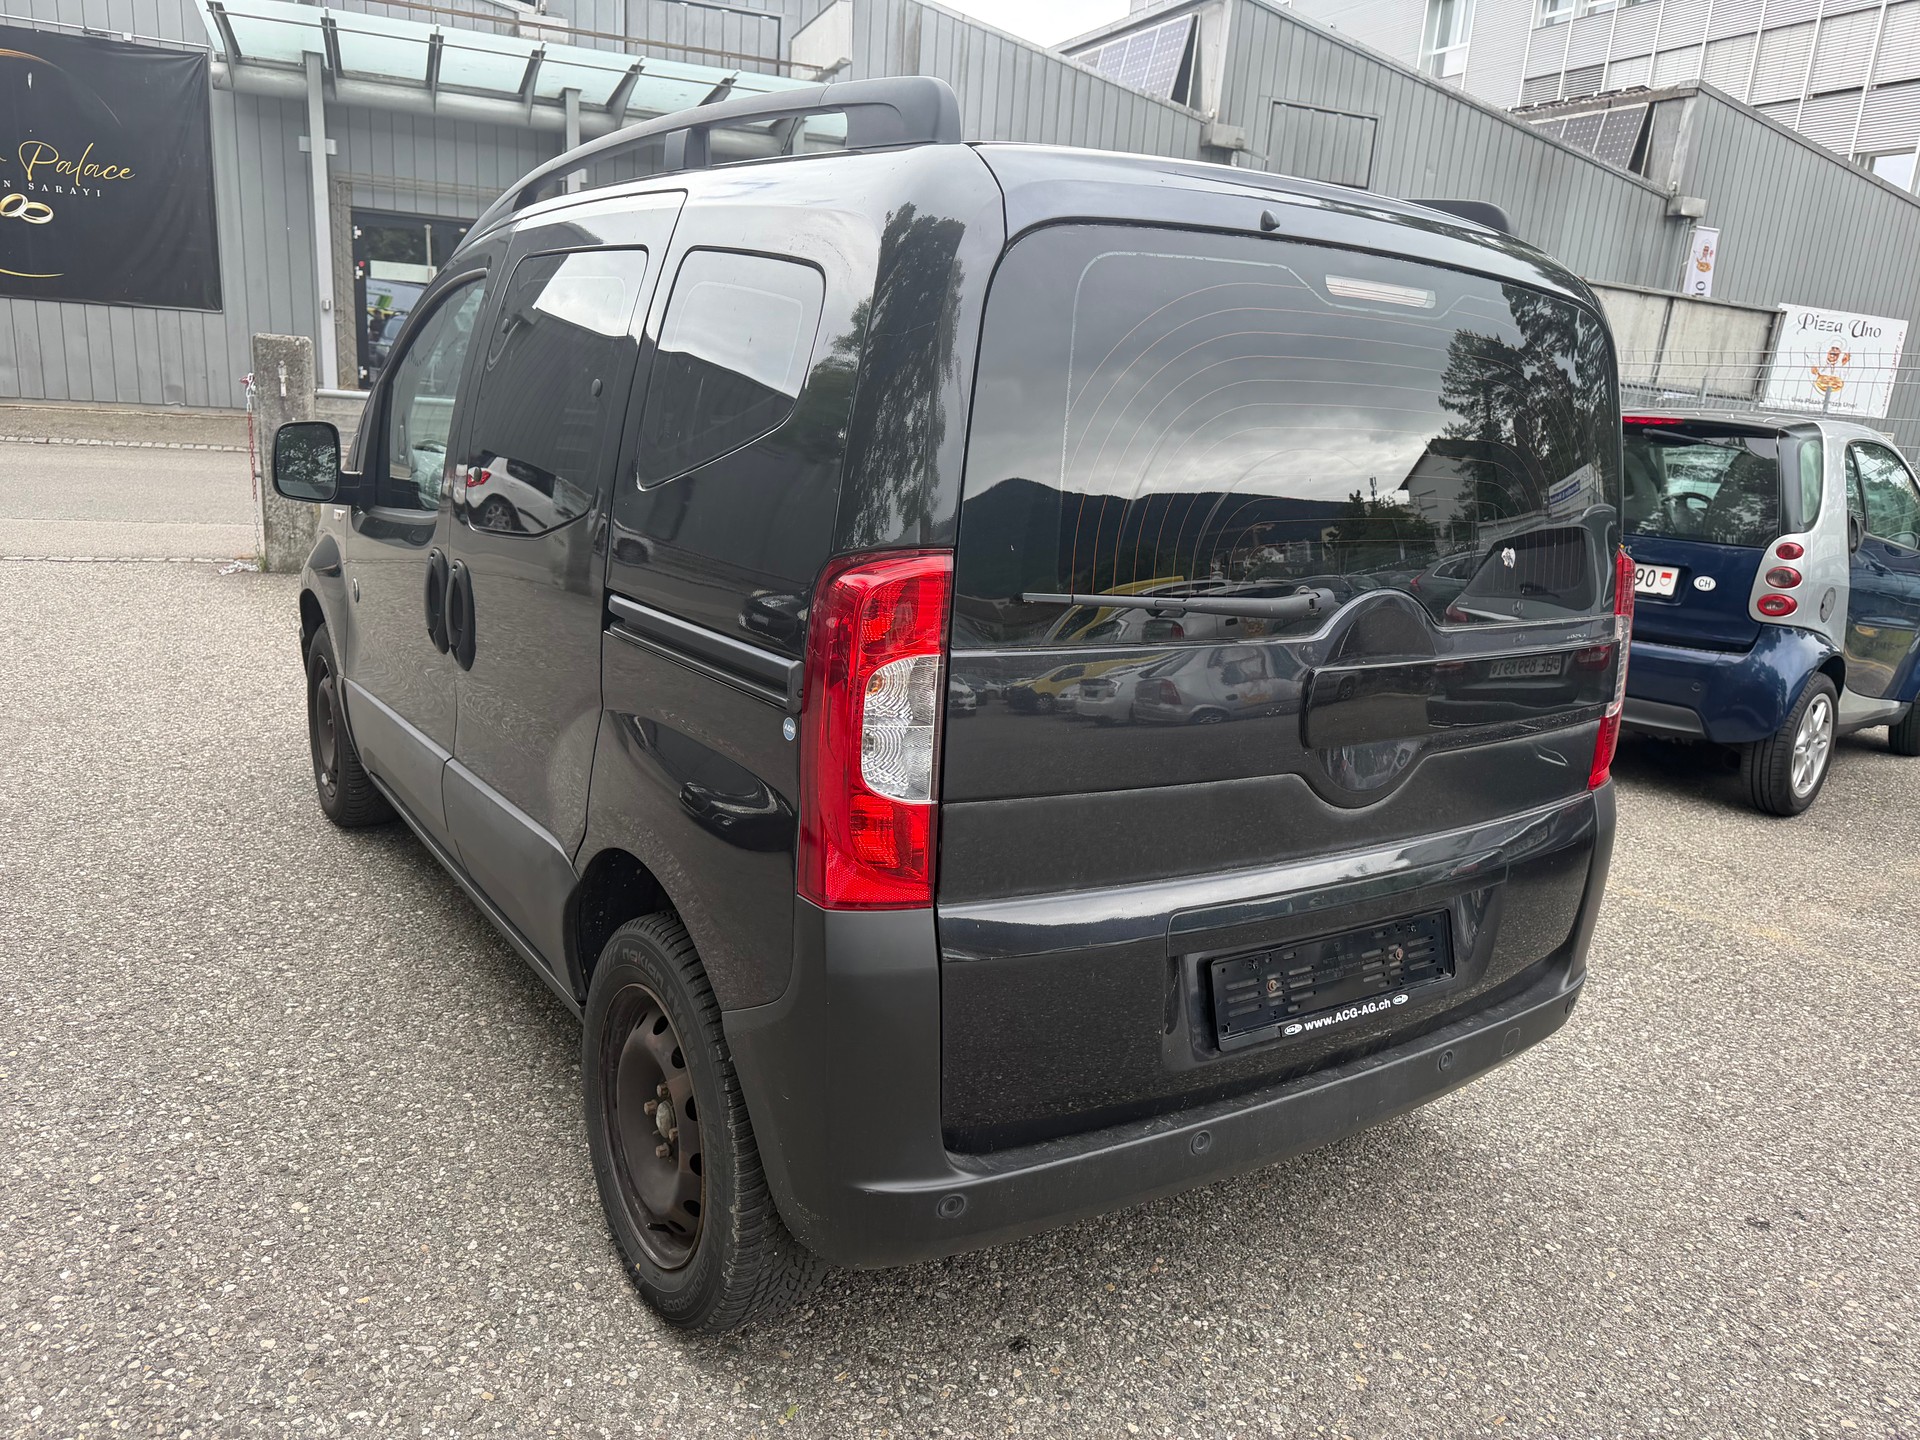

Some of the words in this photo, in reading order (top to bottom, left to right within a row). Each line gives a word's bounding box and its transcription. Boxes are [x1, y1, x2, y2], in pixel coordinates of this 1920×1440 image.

[18, 140, 136, 187] Palace
[3, 179, 11, 188] N
[28, 182, 102, 197] SARAYI
[1797, 312, 1844, 336] Pizza
[1848, 319, 1882, 338] Uno
[1698, 578, 1712, 589] CH
[1304, 999, 1391, 1031] www.ACG-AG.ch
